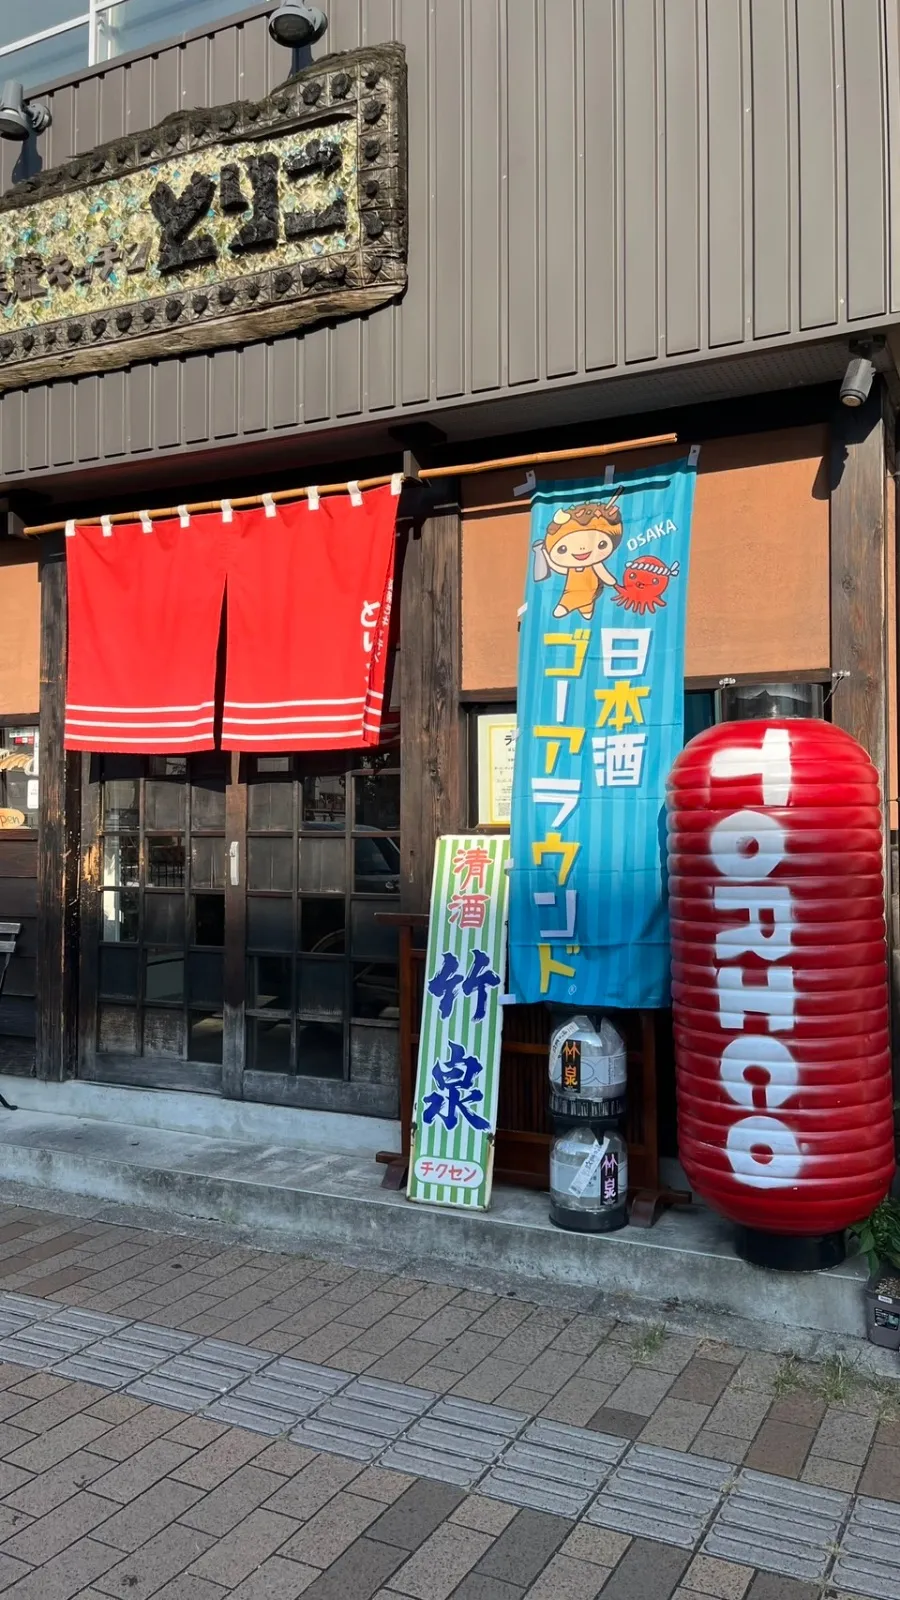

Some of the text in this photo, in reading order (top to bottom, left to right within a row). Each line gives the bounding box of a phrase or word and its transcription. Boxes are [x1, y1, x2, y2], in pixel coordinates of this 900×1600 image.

[627, 518, 677, 551] OSAKA
[592, 628, 652, 788] 日本酒
[448, 847, 493, 930] 清酒
[531, 629, 591, 993] ゴーアラウンド
[711, 728, 801, 1189] TORICO
[421, 949, 502, 1133] 竹泉
[421, 1161, 478, 1183] チクセン
